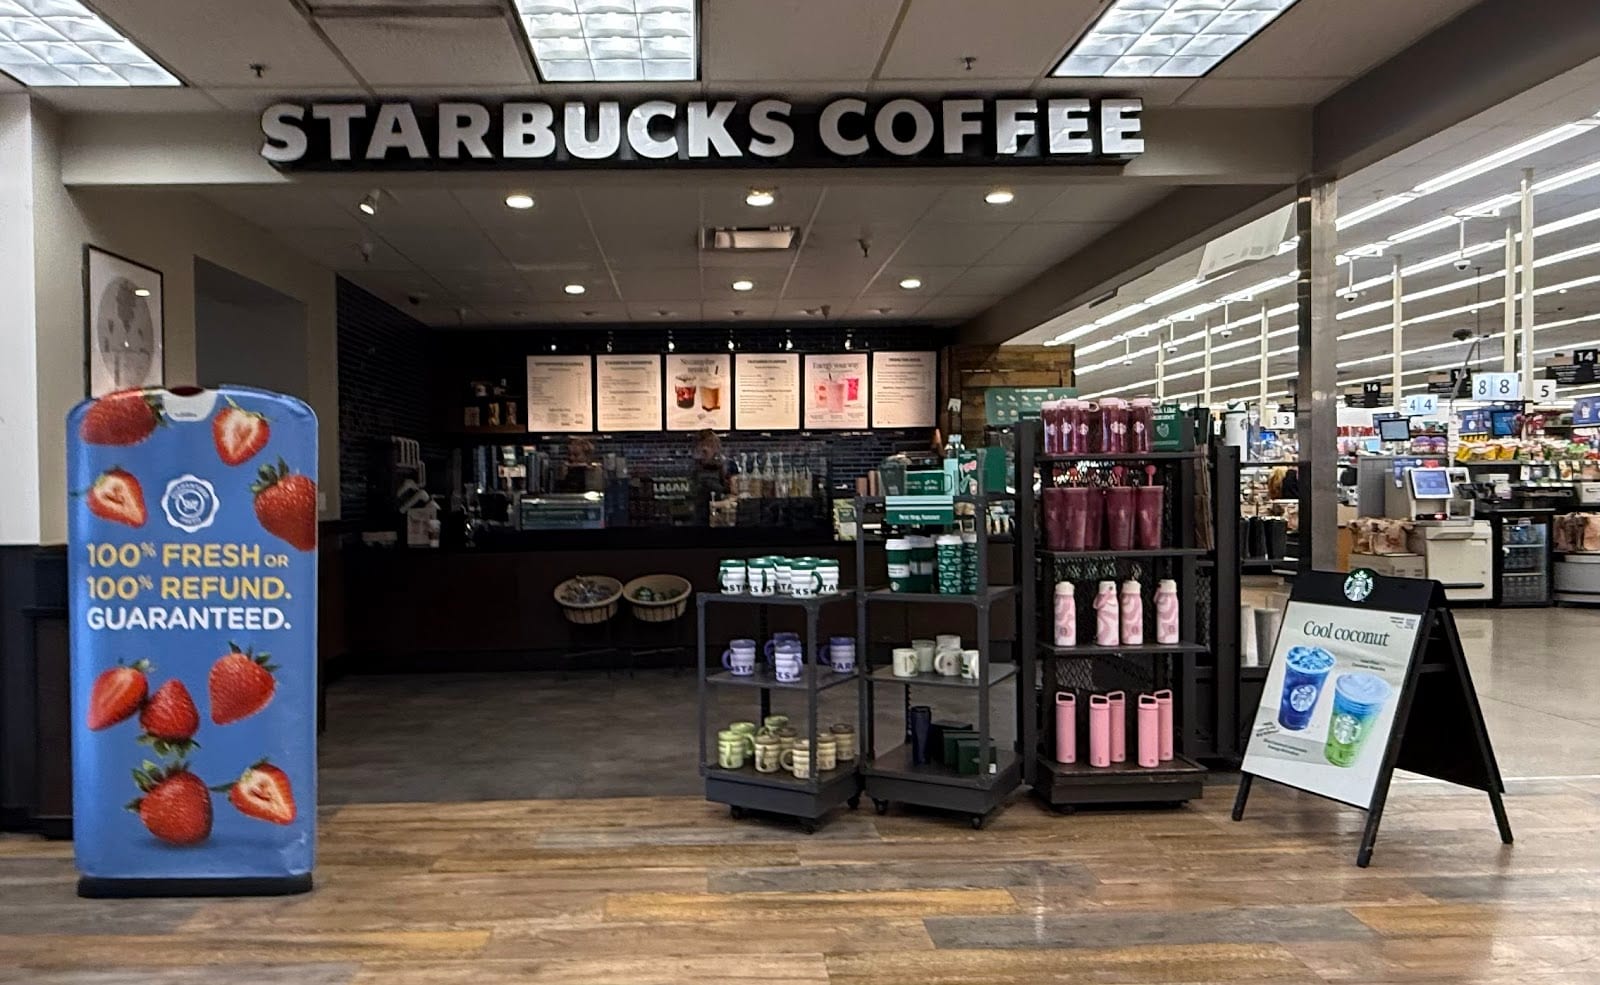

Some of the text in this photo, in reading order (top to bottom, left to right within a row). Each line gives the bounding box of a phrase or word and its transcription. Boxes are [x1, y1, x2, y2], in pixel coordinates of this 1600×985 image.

[260, 98, 1145, 161] STARBUCKS COFFEE
[1577, 351, 1594, 362] 14
[1366, 384, 1379, 392] 16
[1479, 380, 1486, 395] 8
[1500, 379, 1510, 394] 8
[1540, 385, 1550, 398] 5
[1409, 399, 1416, 411] 4
[1424, 399, 1433, 410] 4
[1284, 415, 1290, 425] 3
[86, 542, 289, 568] 100% FRESH OR
[86, 574, 292, 600] 100% REFUND.
[86, 606, 292, 630] GUARANTEED.
[1303, 620, 1391, 647] Cool coconut
